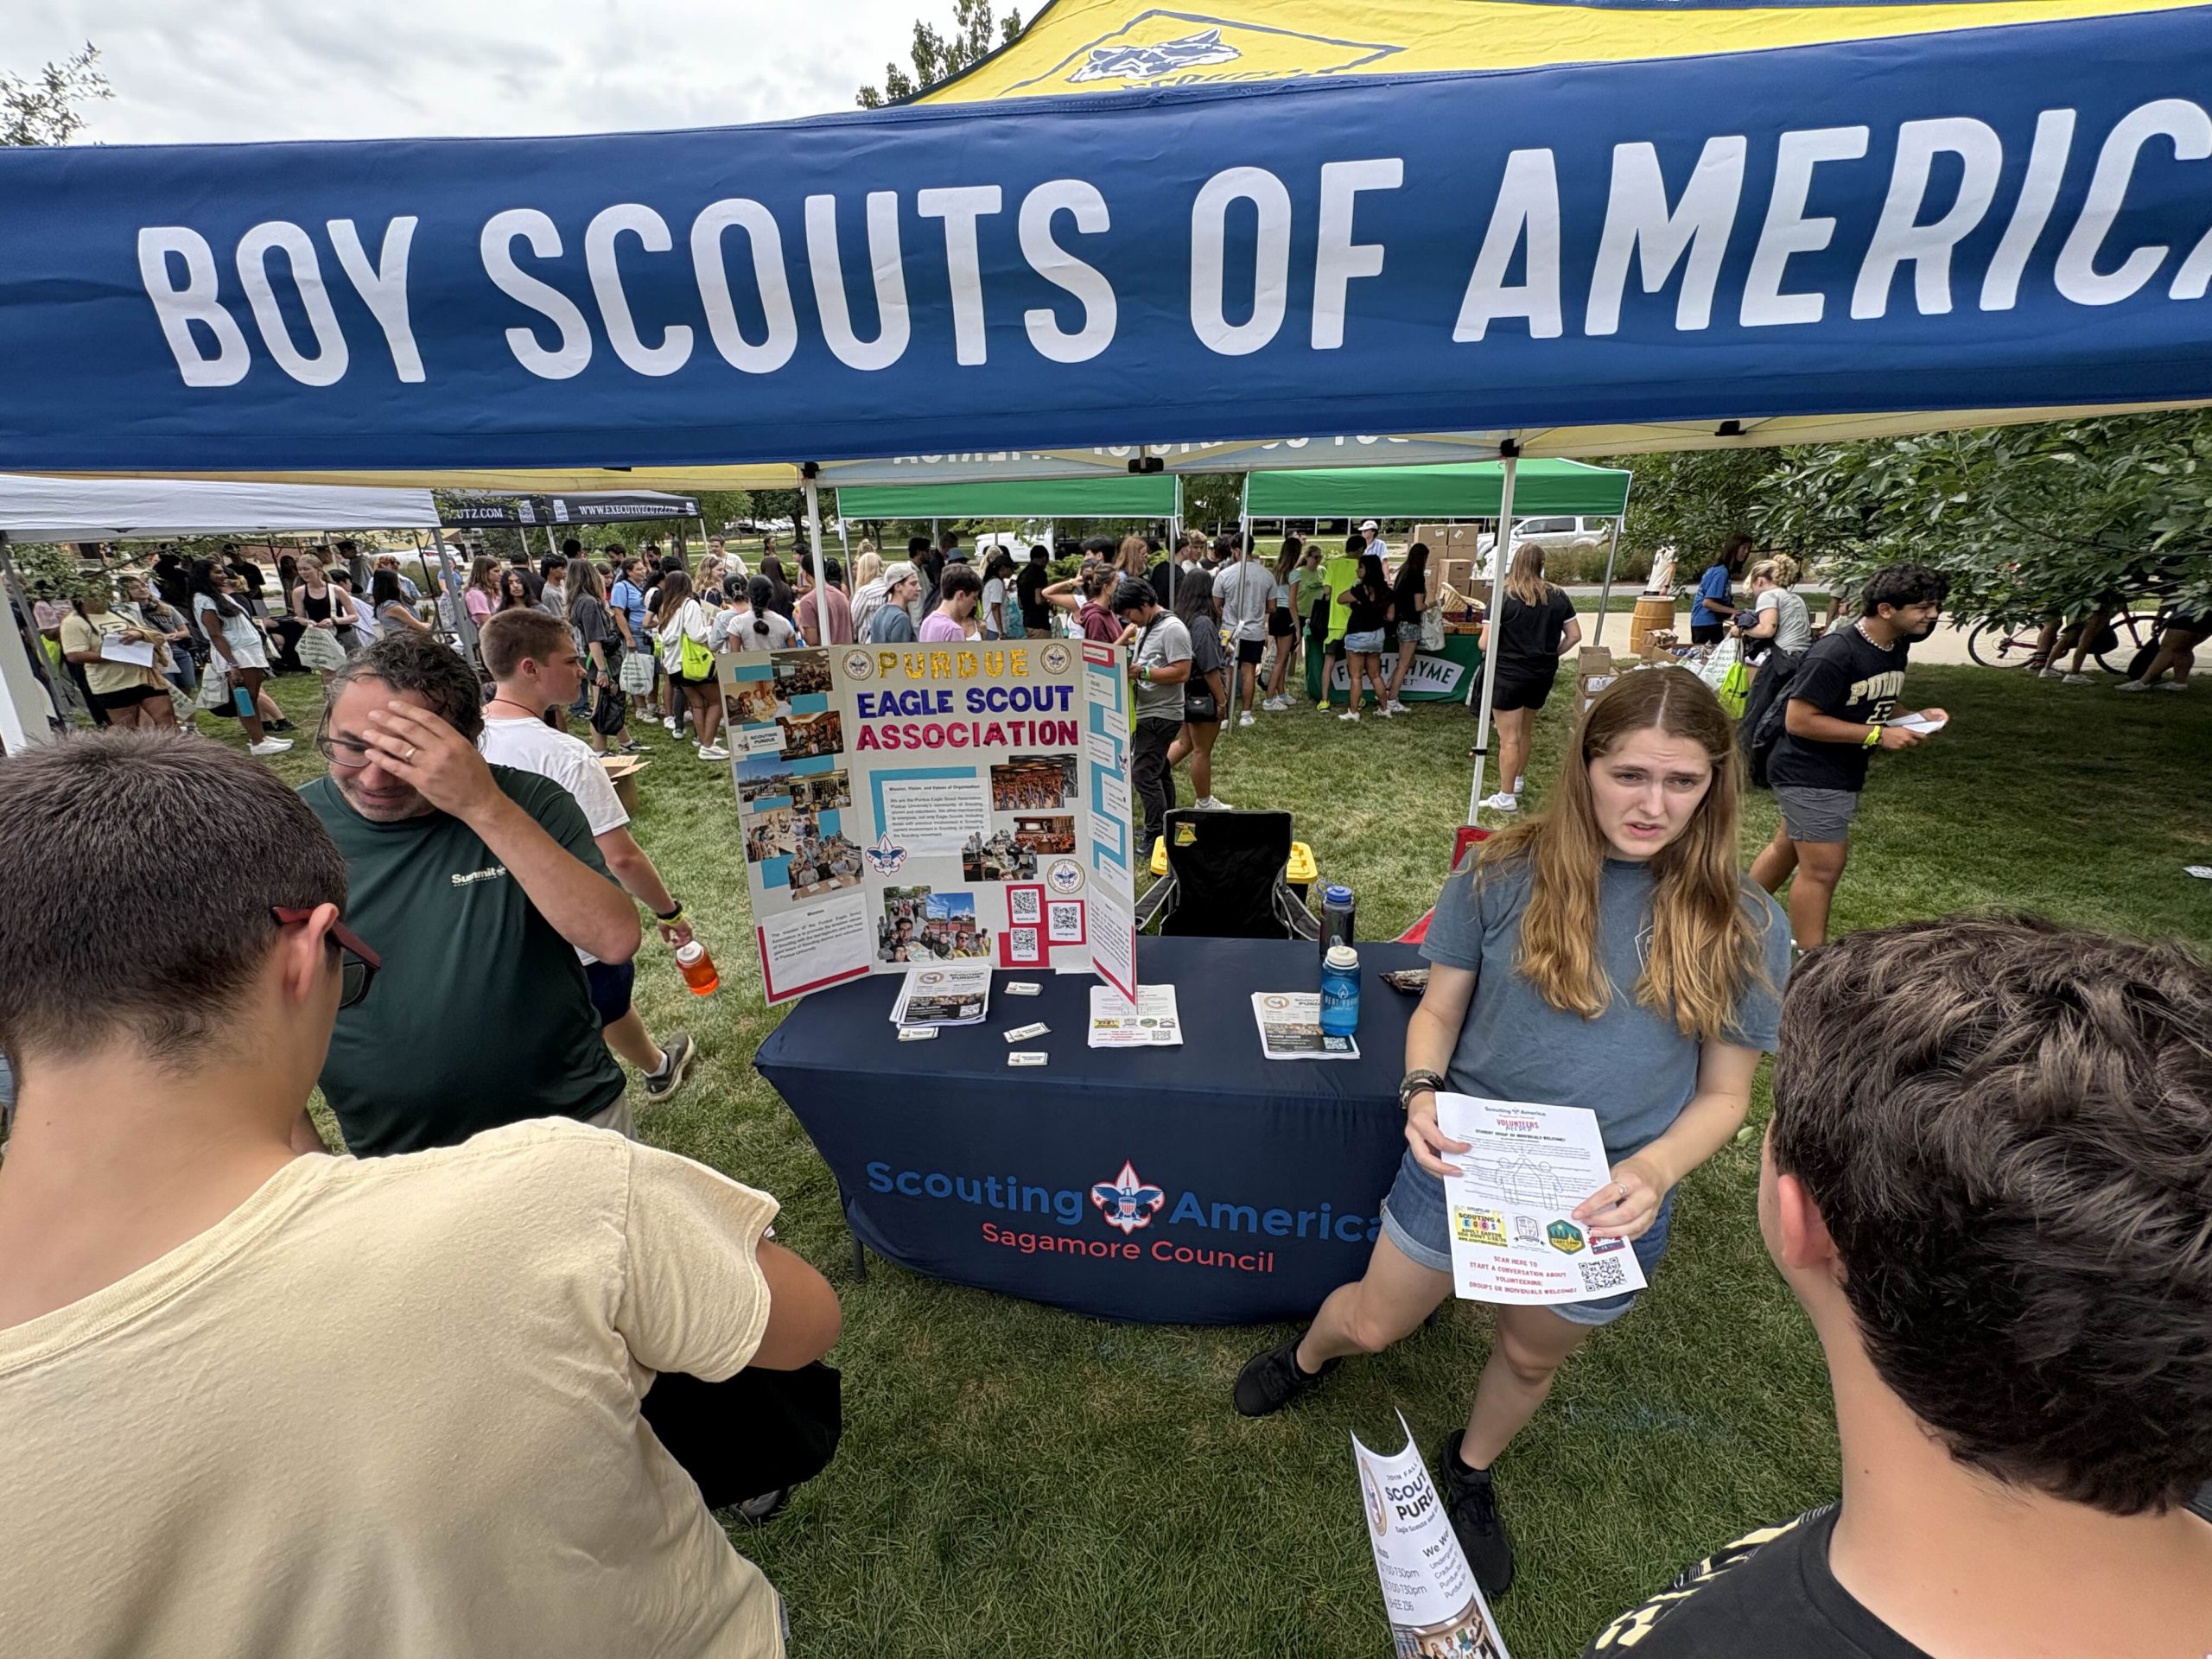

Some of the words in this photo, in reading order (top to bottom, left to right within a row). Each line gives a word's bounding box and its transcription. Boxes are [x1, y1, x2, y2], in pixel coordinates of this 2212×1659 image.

[138, 215, 425, 386] BOY
[480, 178, 1117, 380] SCOUTS
[1191, 158, 1403, 355] OF
[877, 649, 1030, 680] PURDUE
[1396, 658, 1454, 684] HYME
[857, 689, 954, 719] EAGLE
[966, 685, 1074, 714] SCOUT
[856, 720, 1079, 751] ASSOCIATION
[451, 868, 497, 884] Summit
[1497, 1119, 1540, 1128] VOLUNTEERS
[867, 1161, 1084, 1226] Scouting
[1459, 1213, 1495, 1222] SCOUTING
[982, 1222, 1141, 1261] Sagamore
[1150, 1239, 1275, 1274] Council
[1469, 1281, 1492, 1290] GROUPS
[1498, 1267, 1543, 1277] CONVERSATION
[1385, 1467, 1426, 1502] SCOUT
[1403, 1462, 1418, 1478] FALL
[1396, 1484, 1433, 1521] PURD
[1422, 1545, 1440, 1557] We
[1439, 1526, 1449, 1546] We
